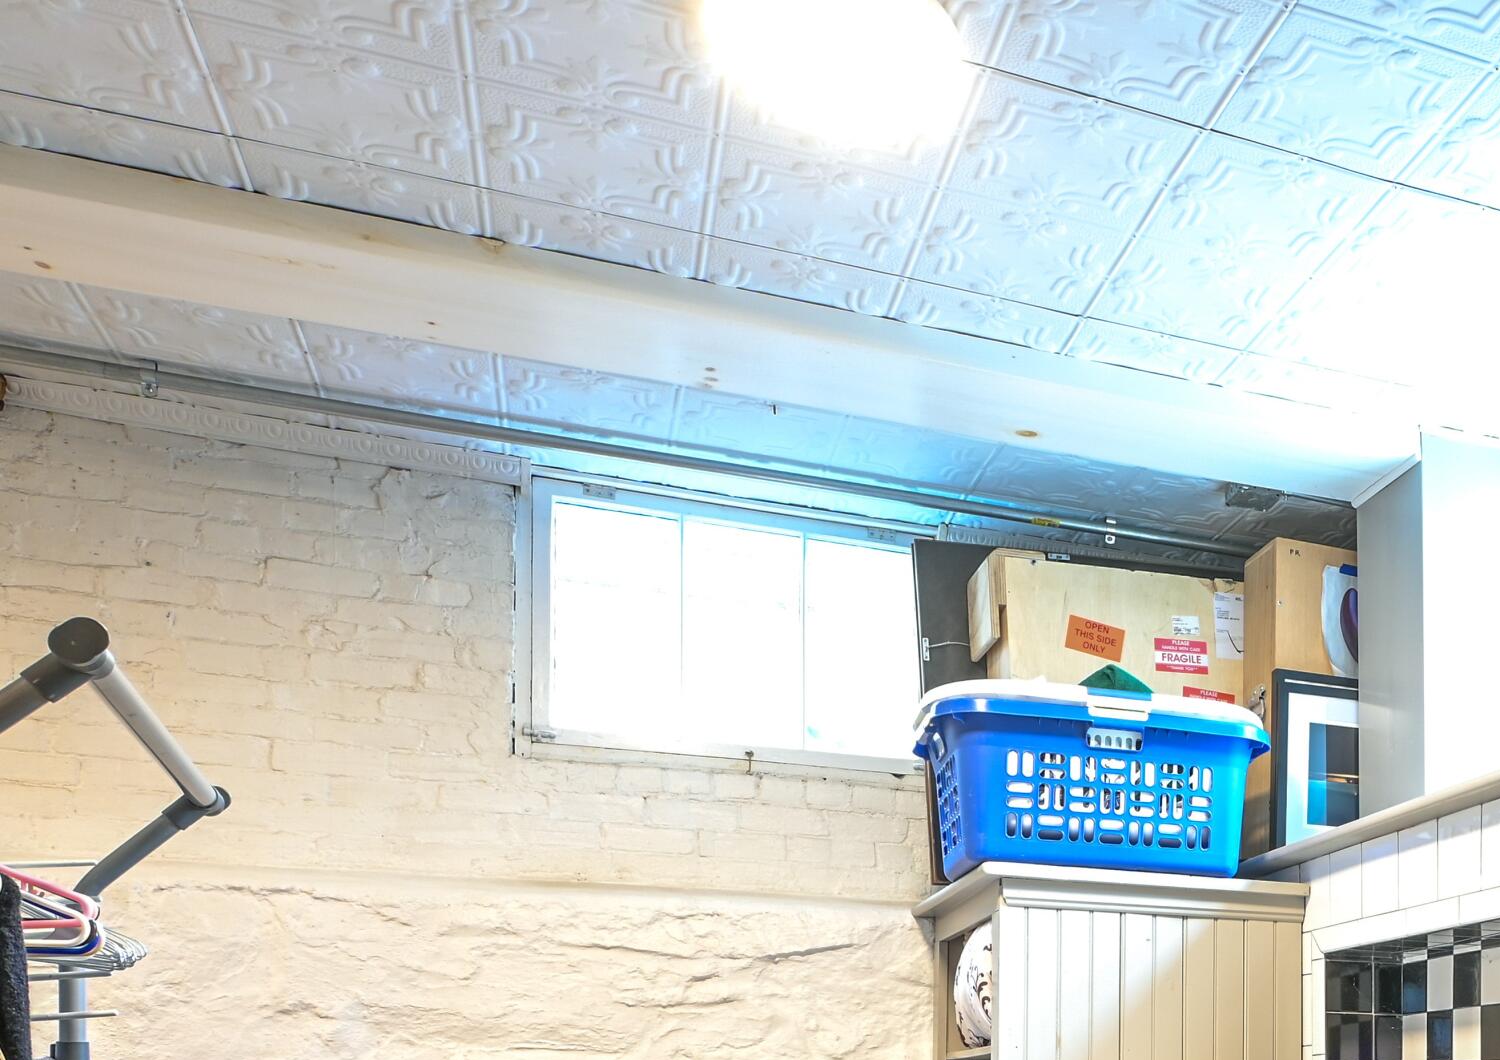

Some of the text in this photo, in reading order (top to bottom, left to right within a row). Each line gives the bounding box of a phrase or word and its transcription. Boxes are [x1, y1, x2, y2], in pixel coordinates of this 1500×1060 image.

[1085, 621, 1110, 634] OPEN
[1075, 628, 1117, 647] THIS SIDE
[1083, 641, 1105, 653] ONLY
[1161, 653, 1202, 664] FRAGILE
[1200, 690, 1218, 698] PLEASE
